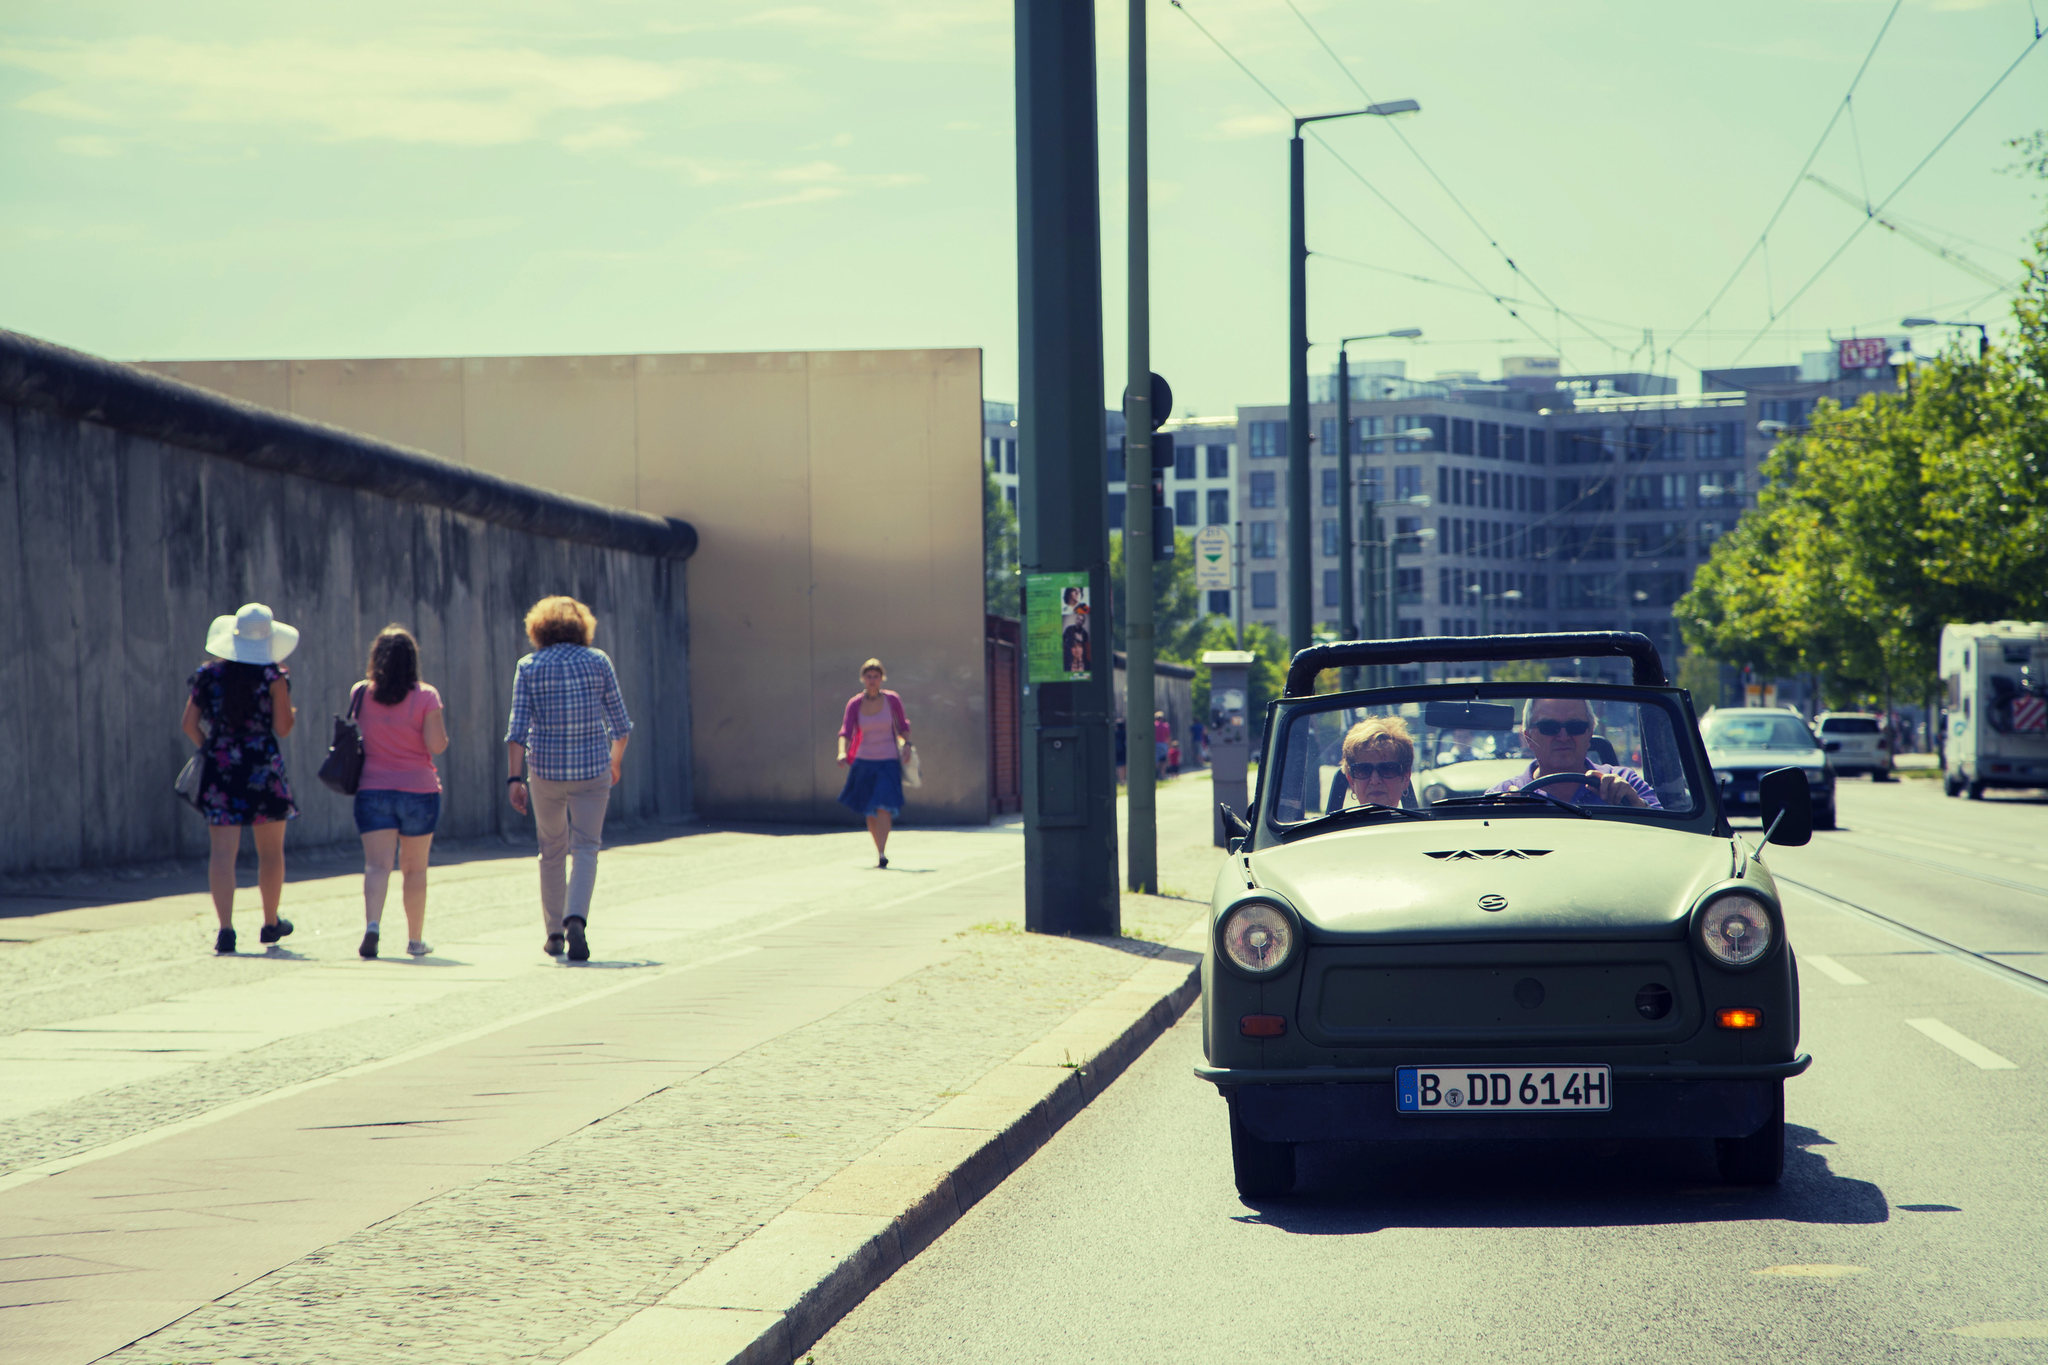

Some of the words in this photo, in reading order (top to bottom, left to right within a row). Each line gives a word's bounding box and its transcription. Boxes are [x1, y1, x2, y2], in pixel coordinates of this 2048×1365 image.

[1404, 1093, 1413, 1104] D
[1420, 1073, 1442, 1106] B
[1466, 1073, 1511, 1106] DD
[1519, 1072, 1606, 1105] 614H
